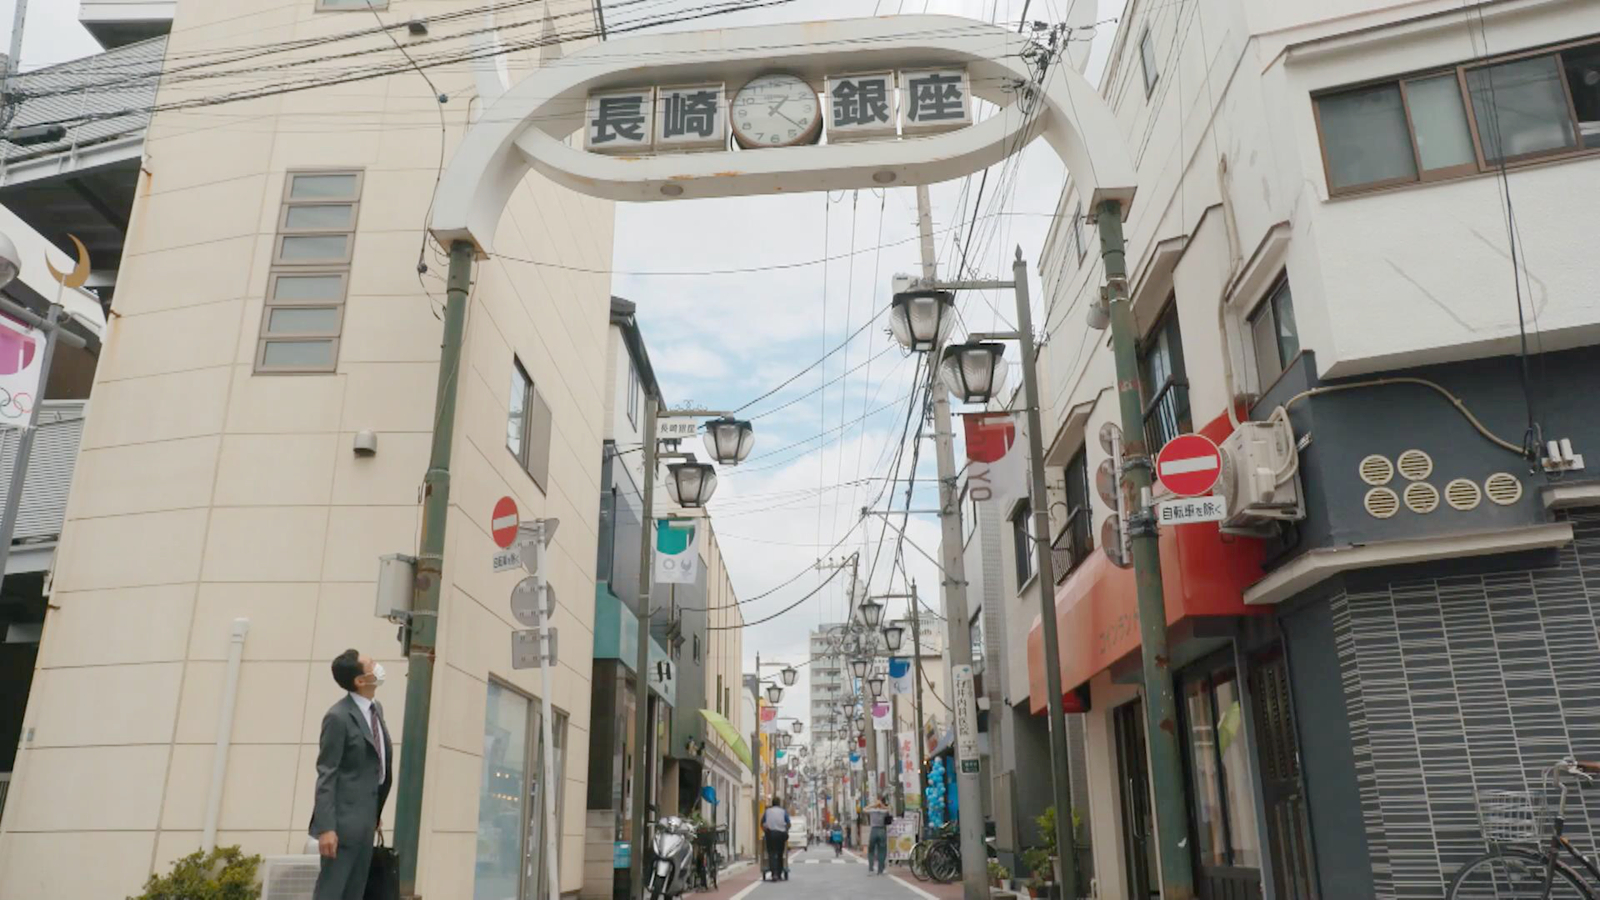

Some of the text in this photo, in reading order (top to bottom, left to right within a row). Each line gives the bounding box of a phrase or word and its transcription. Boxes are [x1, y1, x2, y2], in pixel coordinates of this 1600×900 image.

[742, 98, 755, 106] 10
[591, 74, 965, 145] 長崎 銀座
[803, 104, 812, 113] 3
[738, 109, 747, 117] 9
[742, 122, 752, 130] 8
[755, 132, 764, 140] 7
[770, 134, 780, 143] 6
[1163, 502, 1221, 519] 自転車を除く
